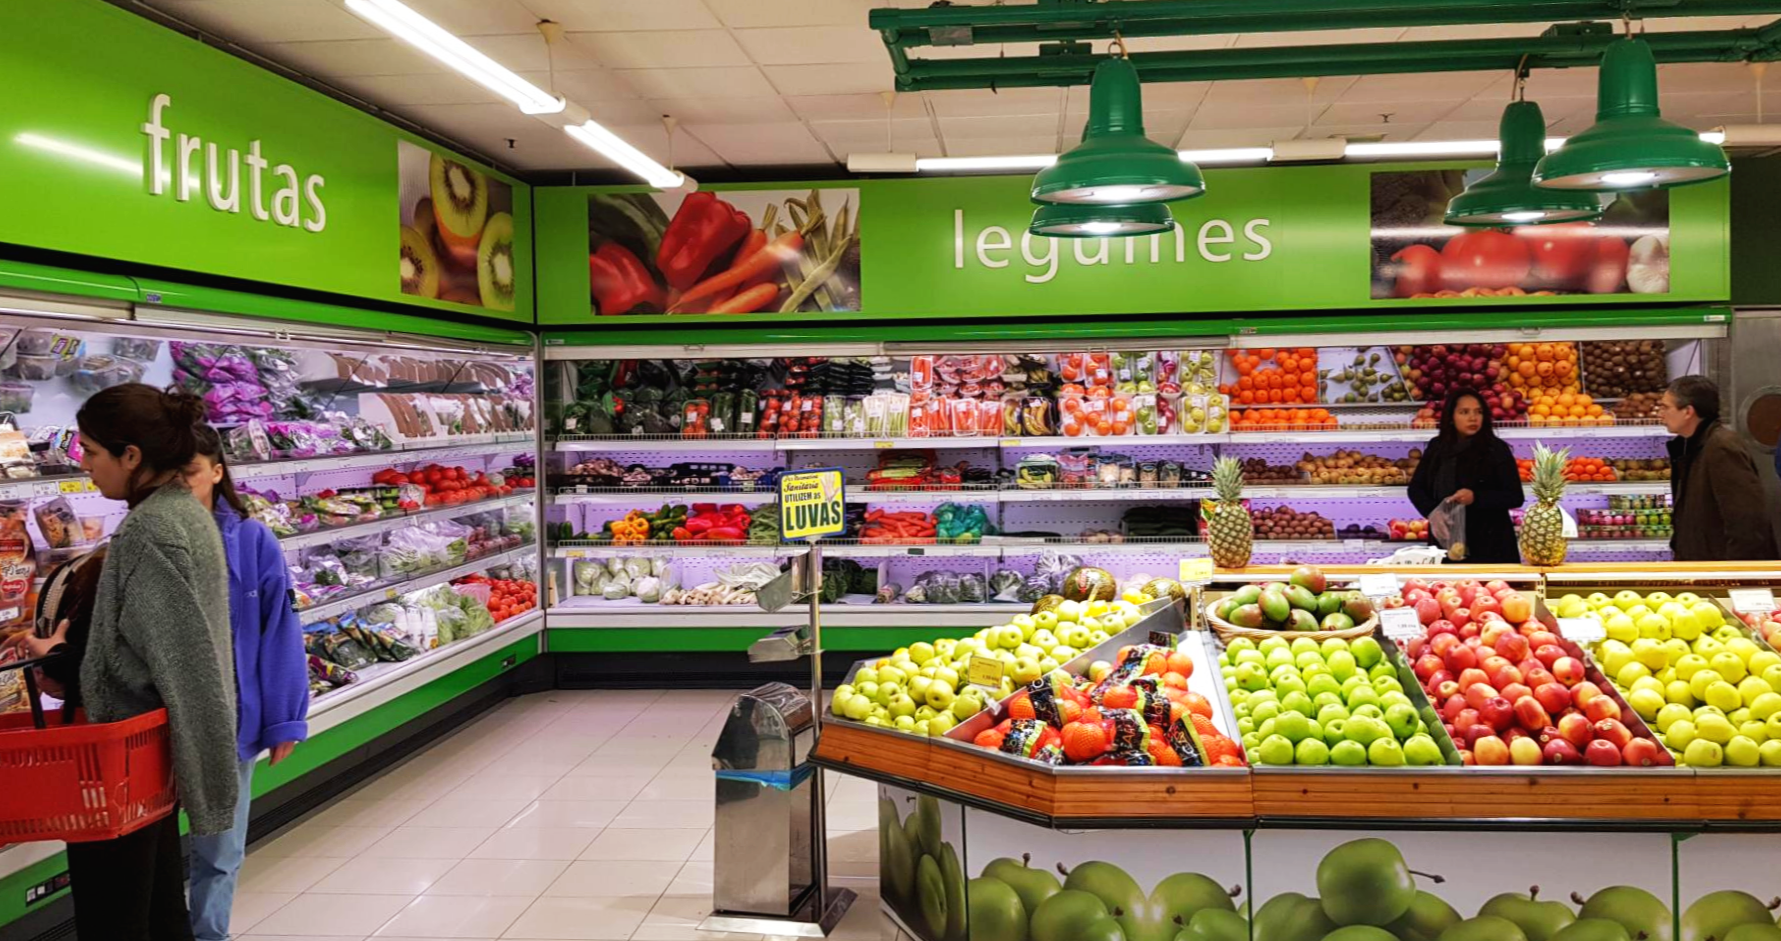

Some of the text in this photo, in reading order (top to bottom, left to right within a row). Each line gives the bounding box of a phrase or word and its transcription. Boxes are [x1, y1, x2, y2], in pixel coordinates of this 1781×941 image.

[141, 94, 326, 232] frutas
[954, 209, 1272, 283] legumes
[785, 492, 812, 503] UTILIZEM
[786, 501, 841, 531] LUVAS
